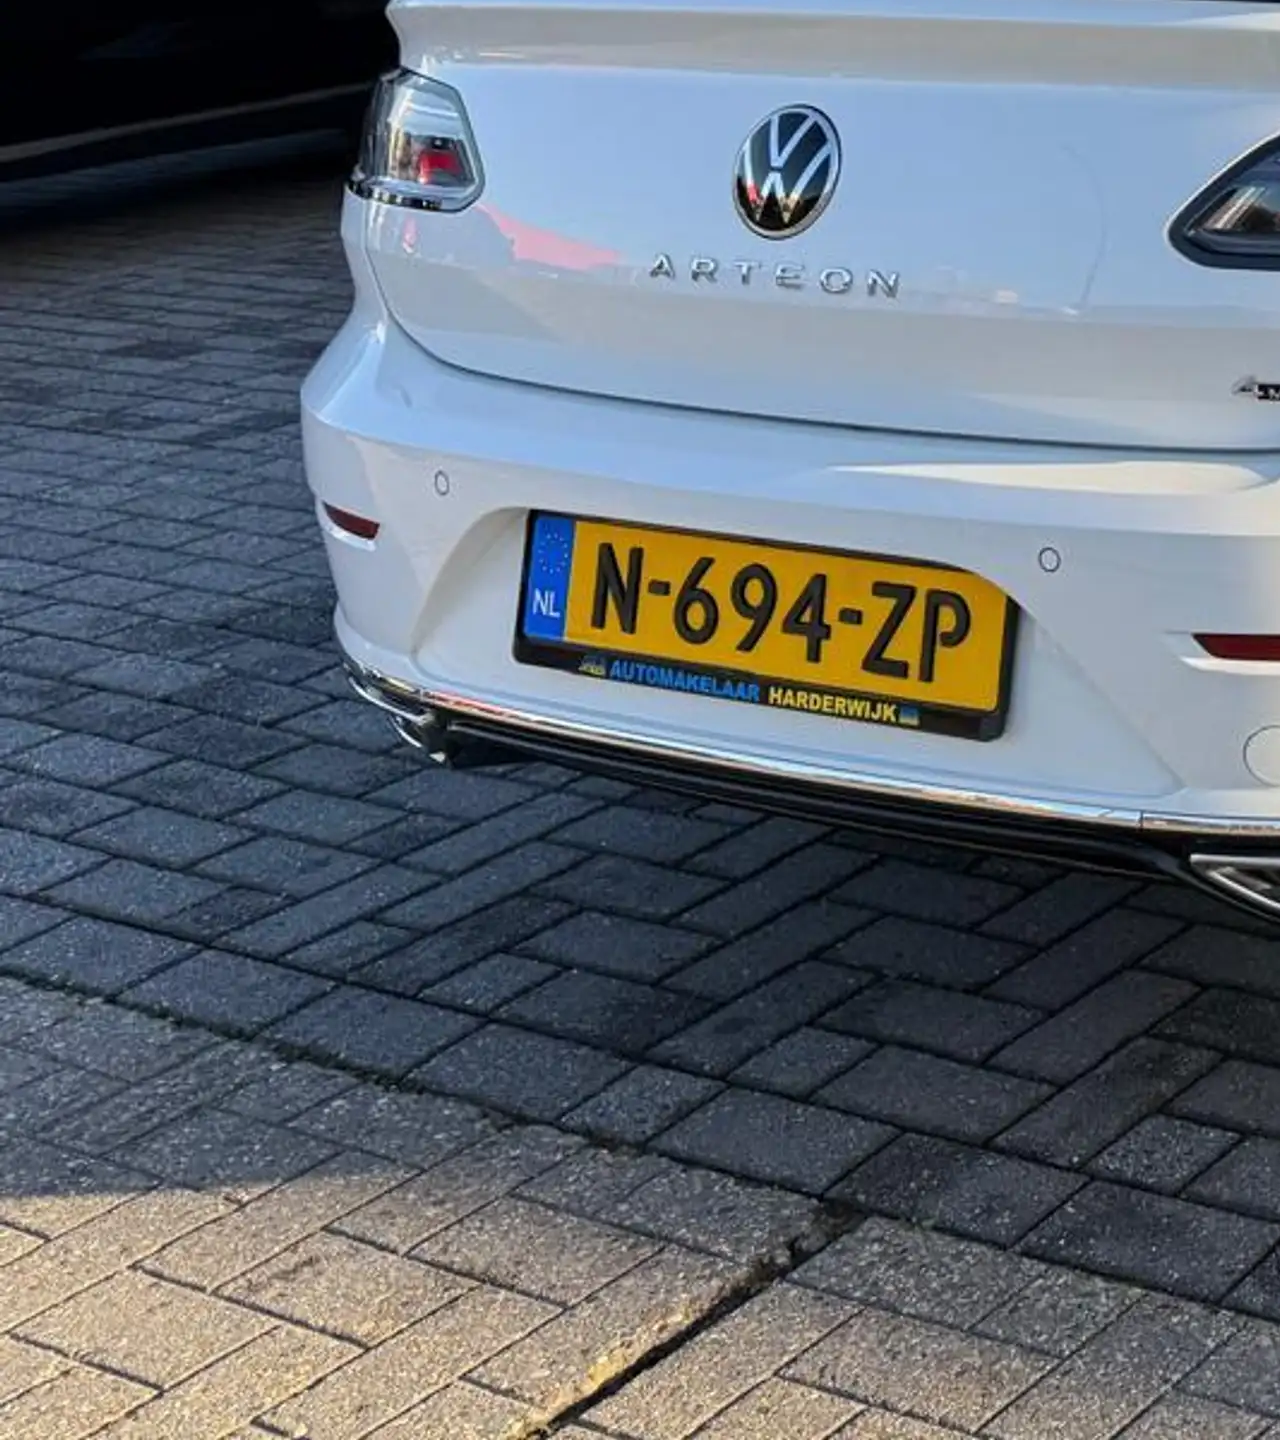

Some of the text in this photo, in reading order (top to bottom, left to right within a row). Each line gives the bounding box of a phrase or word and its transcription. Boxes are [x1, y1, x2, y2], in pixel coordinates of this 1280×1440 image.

[650, 254, 900, 299] ARTEON
[532, 590, 560, 618] NL
[591, 542, 971, 682] N-694-ZP
[609, 659, 760, 703] AUTOMAKELAAR
[768, 685, 898, 723] HARDERWIJK
